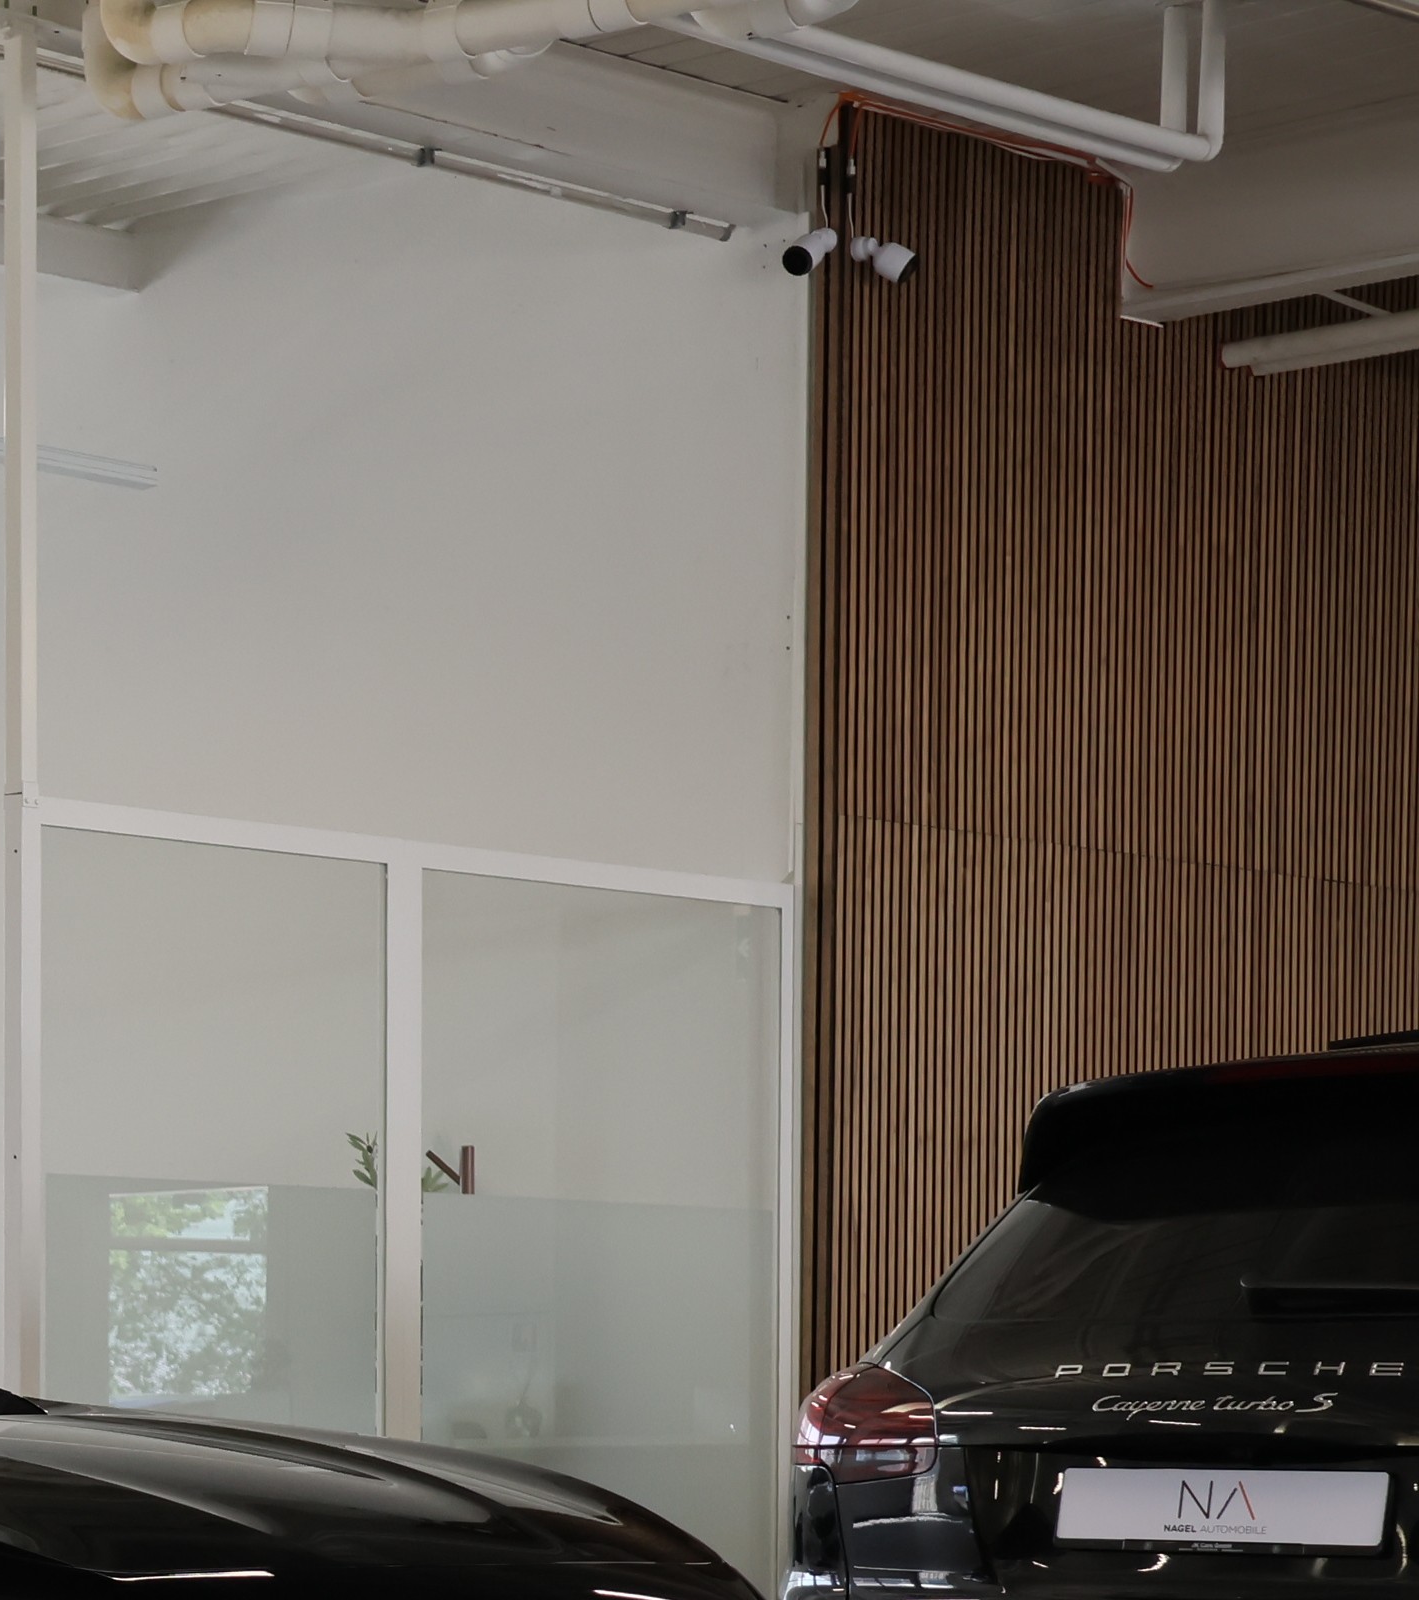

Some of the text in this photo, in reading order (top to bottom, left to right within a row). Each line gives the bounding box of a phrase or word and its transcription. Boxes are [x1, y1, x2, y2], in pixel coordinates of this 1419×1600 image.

[1053, 1360, 1405, 1379] PORSCHE
[1091, 1394, 1206, 1420] Cayenne
[1295, 1392, 1339, 1413] S
[1163, 1524, 1268, 1535] NAGEL AUTOMOBILE
